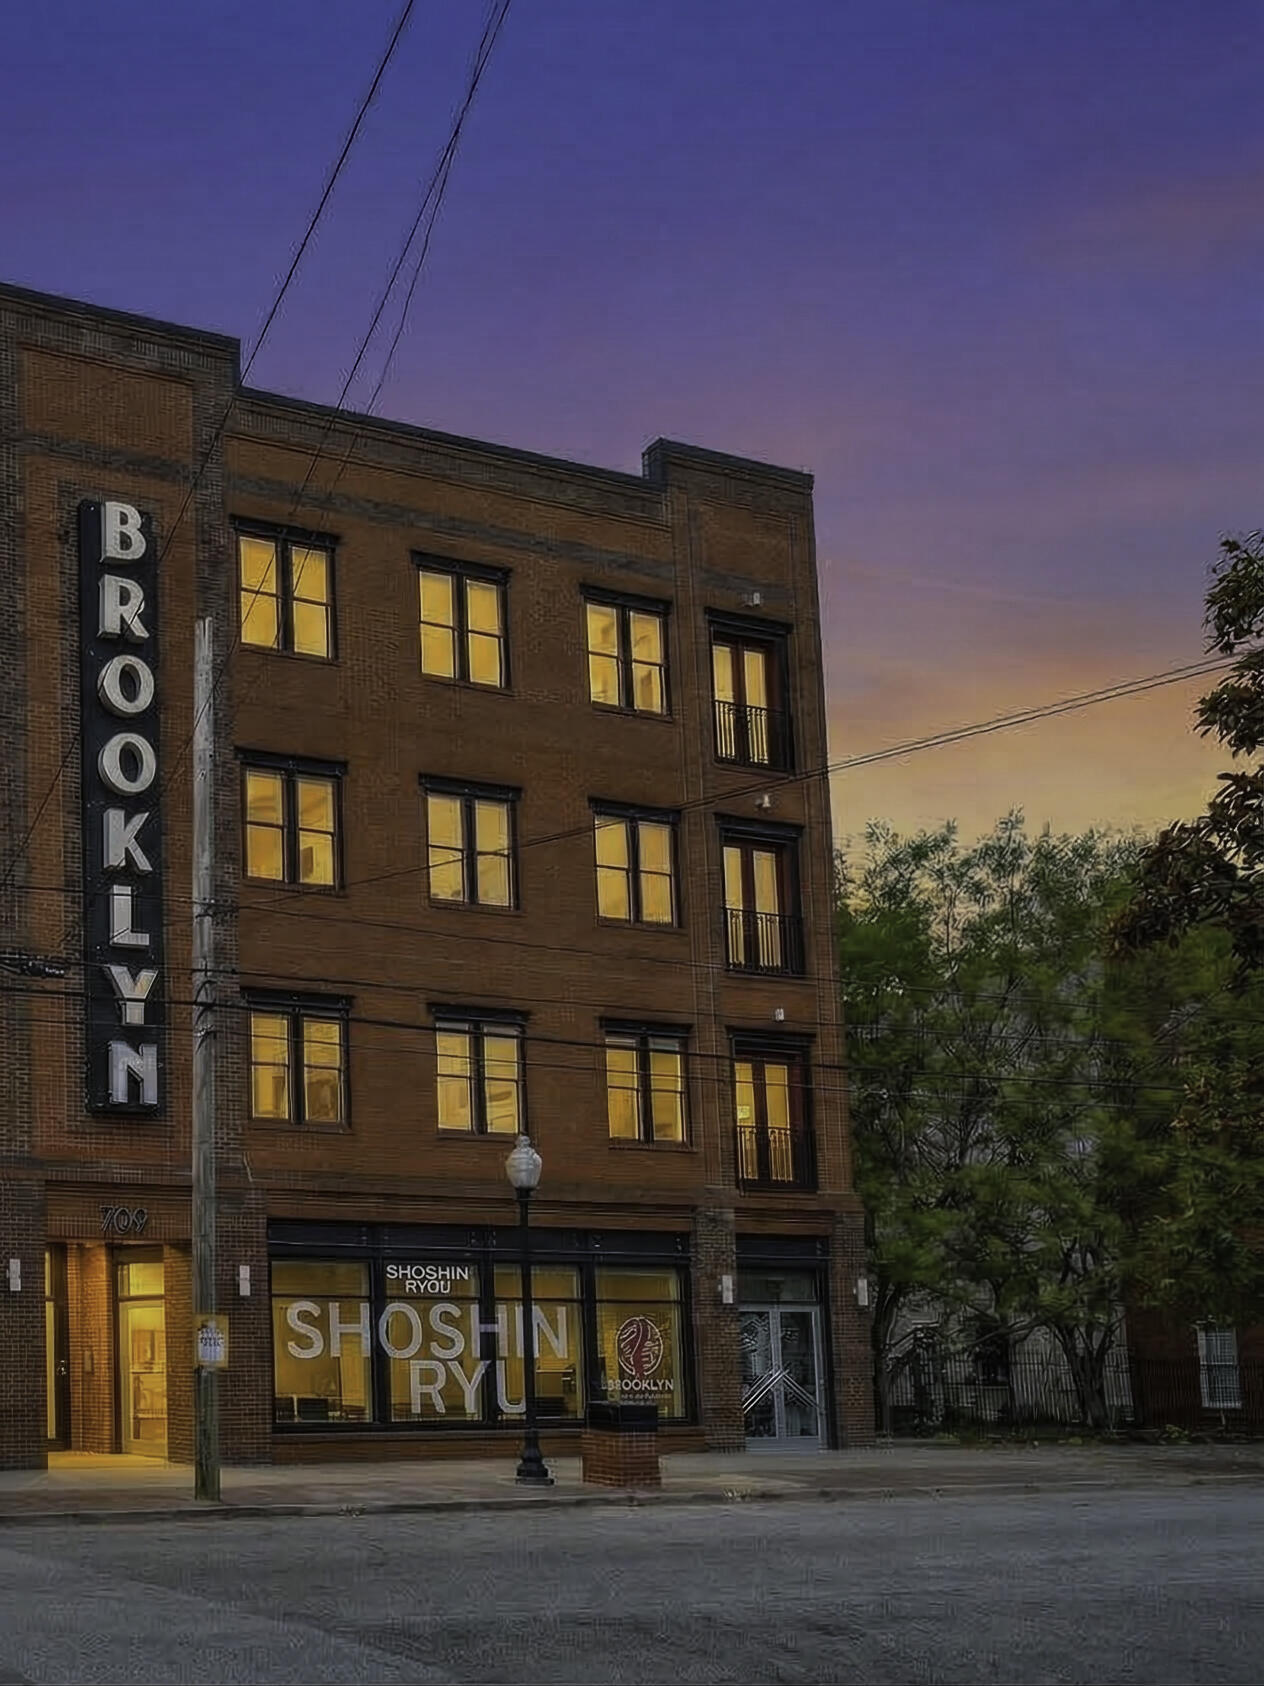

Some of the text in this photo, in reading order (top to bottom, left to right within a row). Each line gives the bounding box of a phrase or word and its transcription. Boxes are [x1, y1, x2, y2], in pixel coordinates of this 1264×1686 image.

[98, 500, 159, 1107] BROOKLYN
[100, 1205, 148, 1234] 709
[386, 1264, 469, 1280] SHOSHIN
[405, 1280, 451, 1293] RYOU
[286, 1301, 568, 1359] SHOSHIN
[409, 1360, 526, 1414] RYU
[606, 1379, 674, 1391] BROOKLYN
